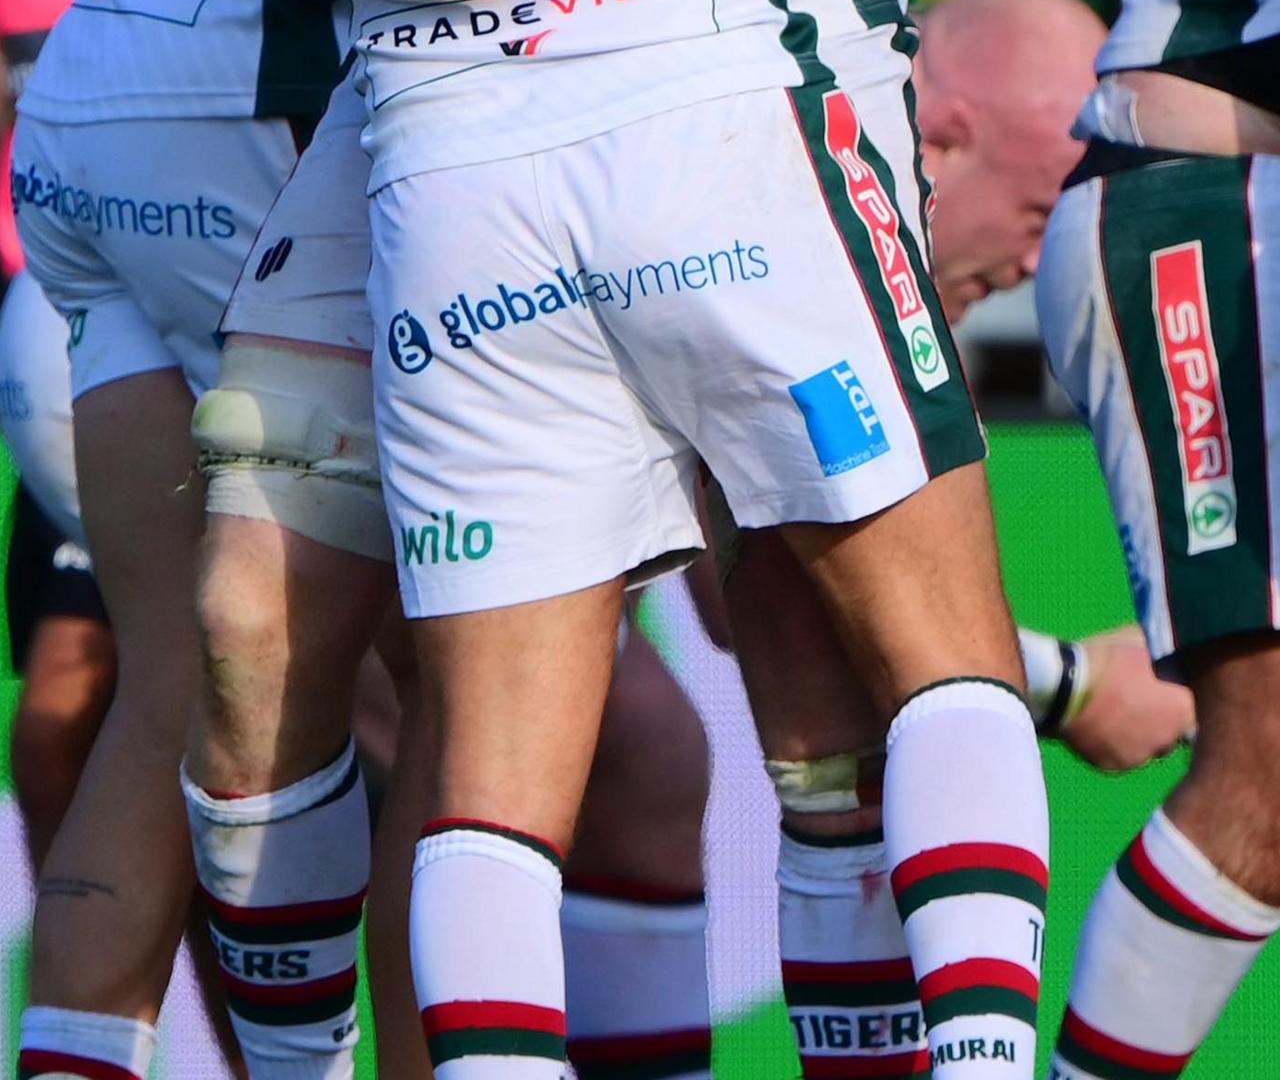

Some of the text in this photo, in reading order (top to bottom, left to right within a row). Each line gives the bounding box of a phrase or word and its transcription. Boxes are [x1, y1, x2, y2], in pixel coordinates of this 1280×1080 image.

[836, 146, 918, 315] SPAR
[831, 367, 880, 437] TDT
[1164, 301, 1222, 479] SPAR
[401, 510, 494, 567] wilo
